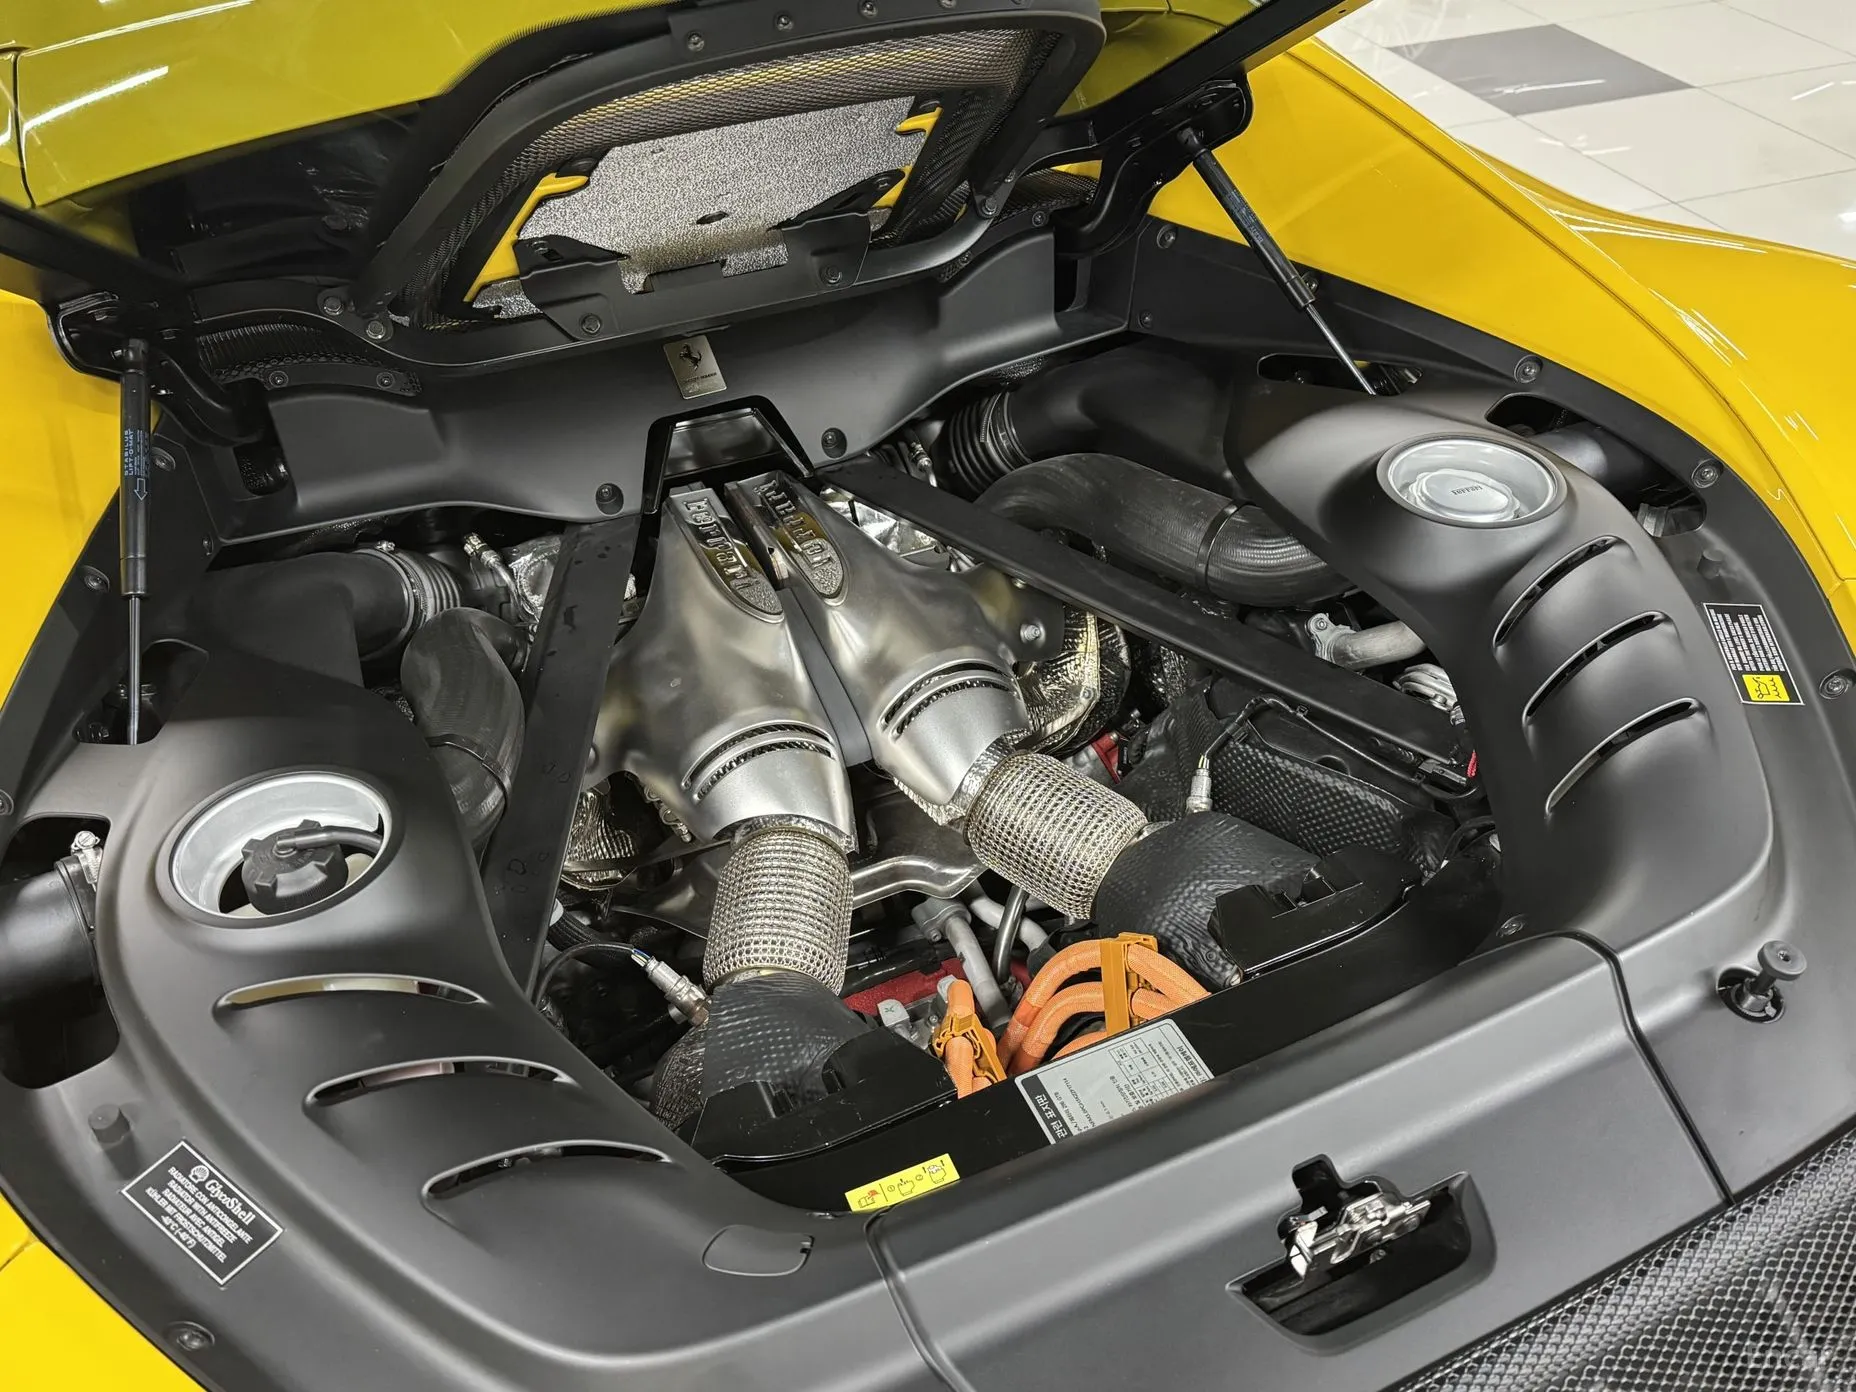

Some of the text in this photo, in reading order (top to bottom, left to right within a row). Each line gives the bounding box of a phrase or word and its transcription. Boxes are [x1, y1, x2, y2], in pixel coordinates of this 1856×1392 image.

[1451, 485, 1483, 495] Ferrari
[684, 497, 760, 590] Ferrari
[753, 480, 835, 569] Ferrari
[1034, 1094, 1067, 1138] 관련 표지판
[168, 1167, 197, 1193] RADIATORE
[195, 1191, 208, 1203] CON
[204, 1179, 256, 1226] GlycoShell
[162, 1189, 191, 1215] RADIATEUR
[189, 1213, 205, 1227] AVEC
[167, 1180, 236, 1242] RADIATOR WITH ANTIFREEZE
